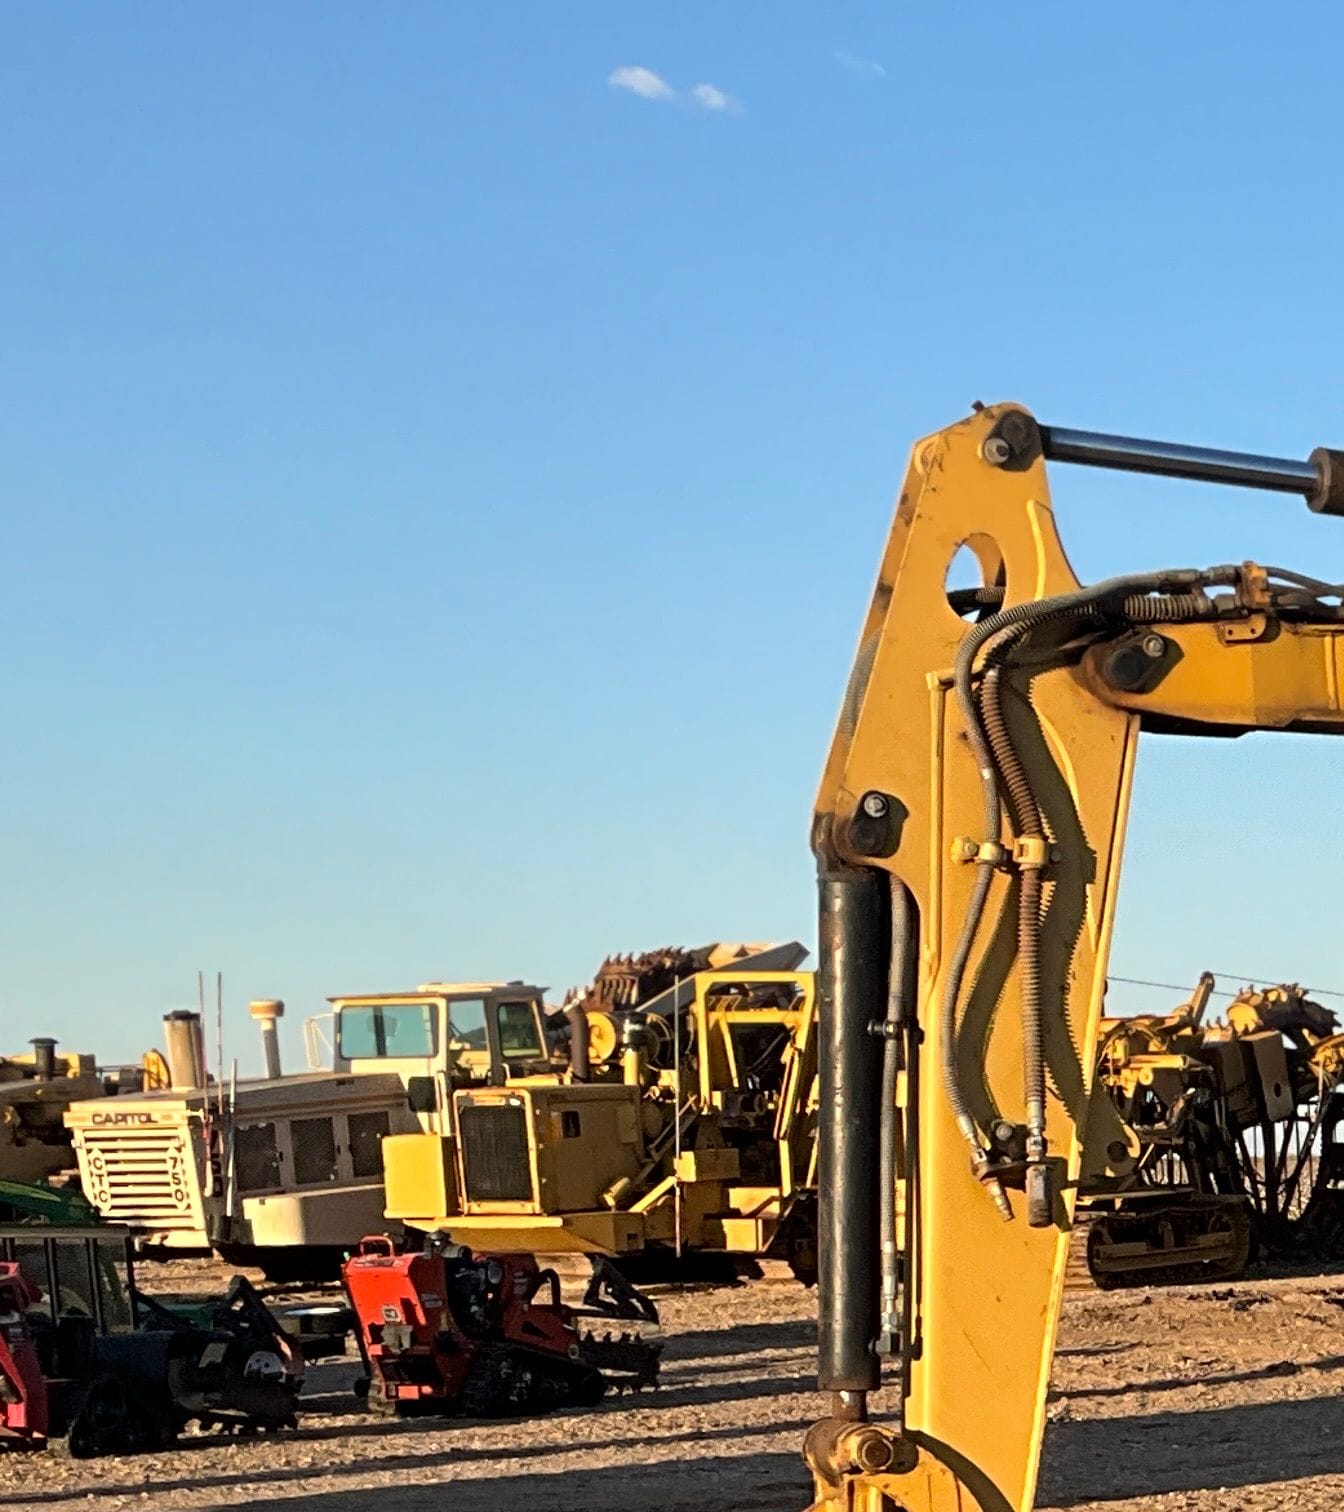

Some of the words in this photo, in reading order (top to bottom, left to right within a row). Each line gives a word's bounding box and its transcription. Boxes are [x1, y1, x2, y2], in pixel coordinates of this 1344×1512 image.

[92, 1112, 158, 1125] CAPITOL
[92, 1156, 109, 1204] CTC
[168, 1156, 186, 1202] 750
